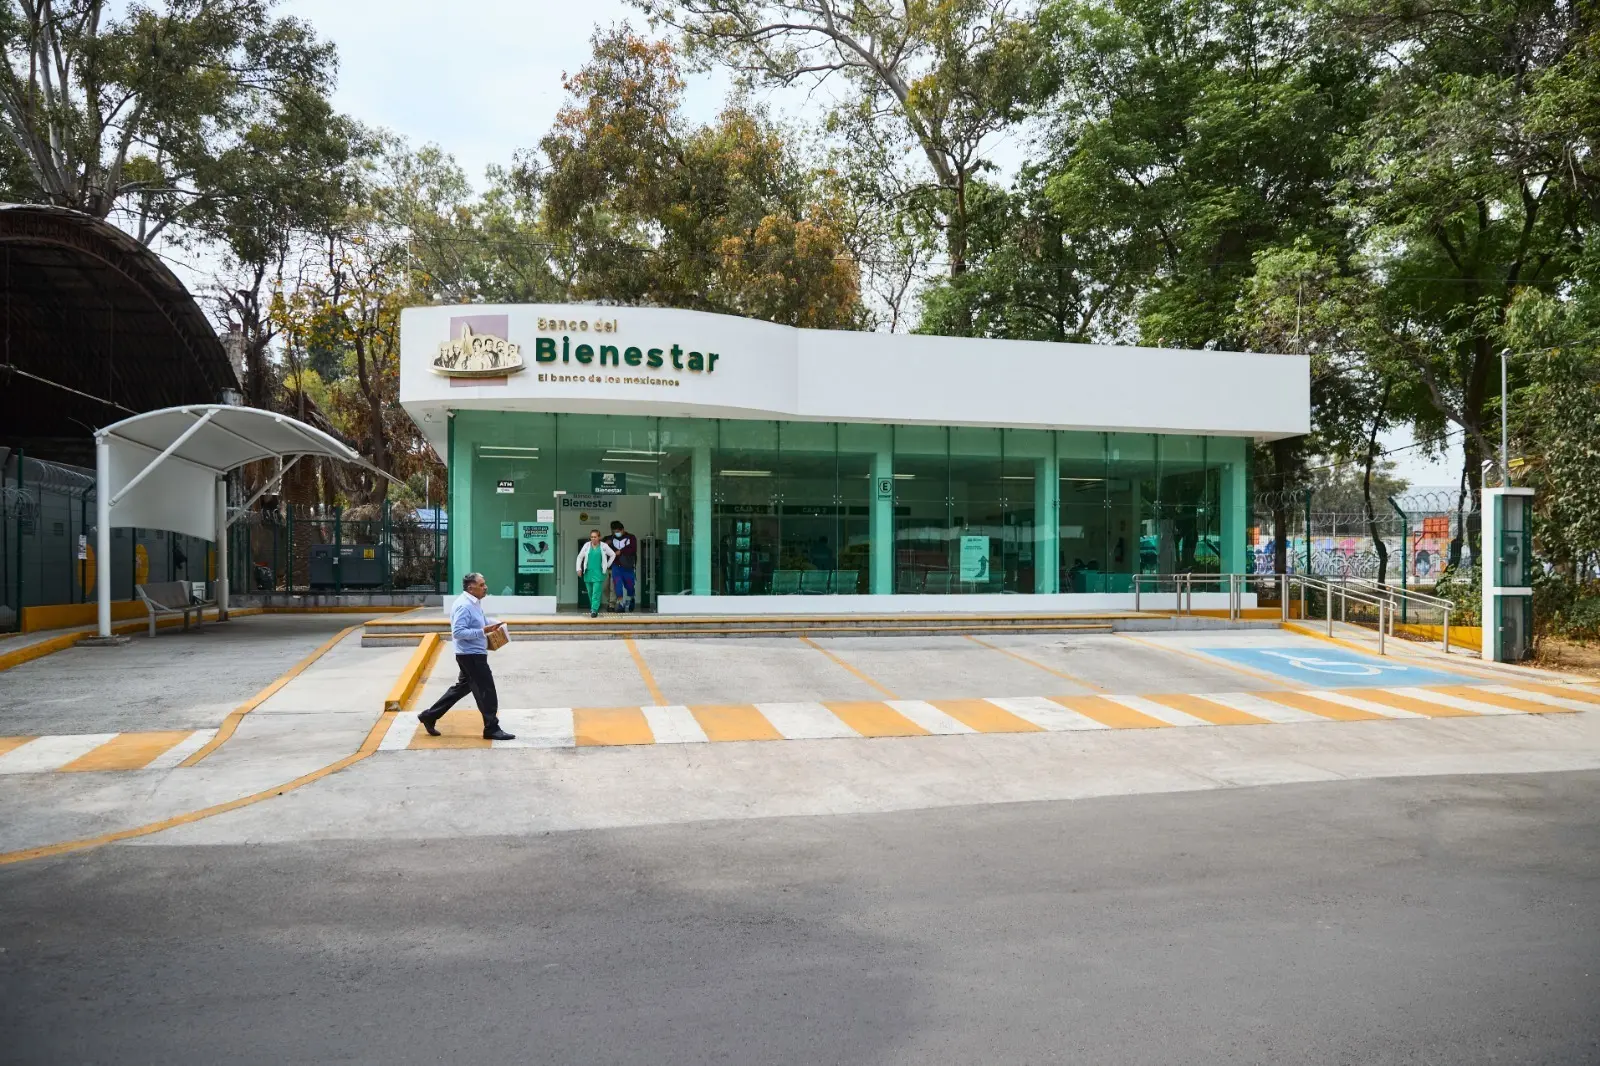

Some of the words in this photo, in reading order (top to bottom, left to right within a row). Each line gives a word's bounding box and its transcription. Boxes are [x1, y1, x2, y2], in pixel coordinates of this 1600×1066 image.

[537, 316, 589, 332] Banco
[593, 318, 618, 333] del
[535, 336, 720, 373] Bienestar
[538, 373, 548, 382] El
[551, 373, 586, 383] banco
[588, 374, 602, 383] de
[605, 375, 621, 384] los
[623, 376, 680, 387] mexicanos
[882, 482, 888, 491] E
[562, 498, 613, 508] Bienestar
